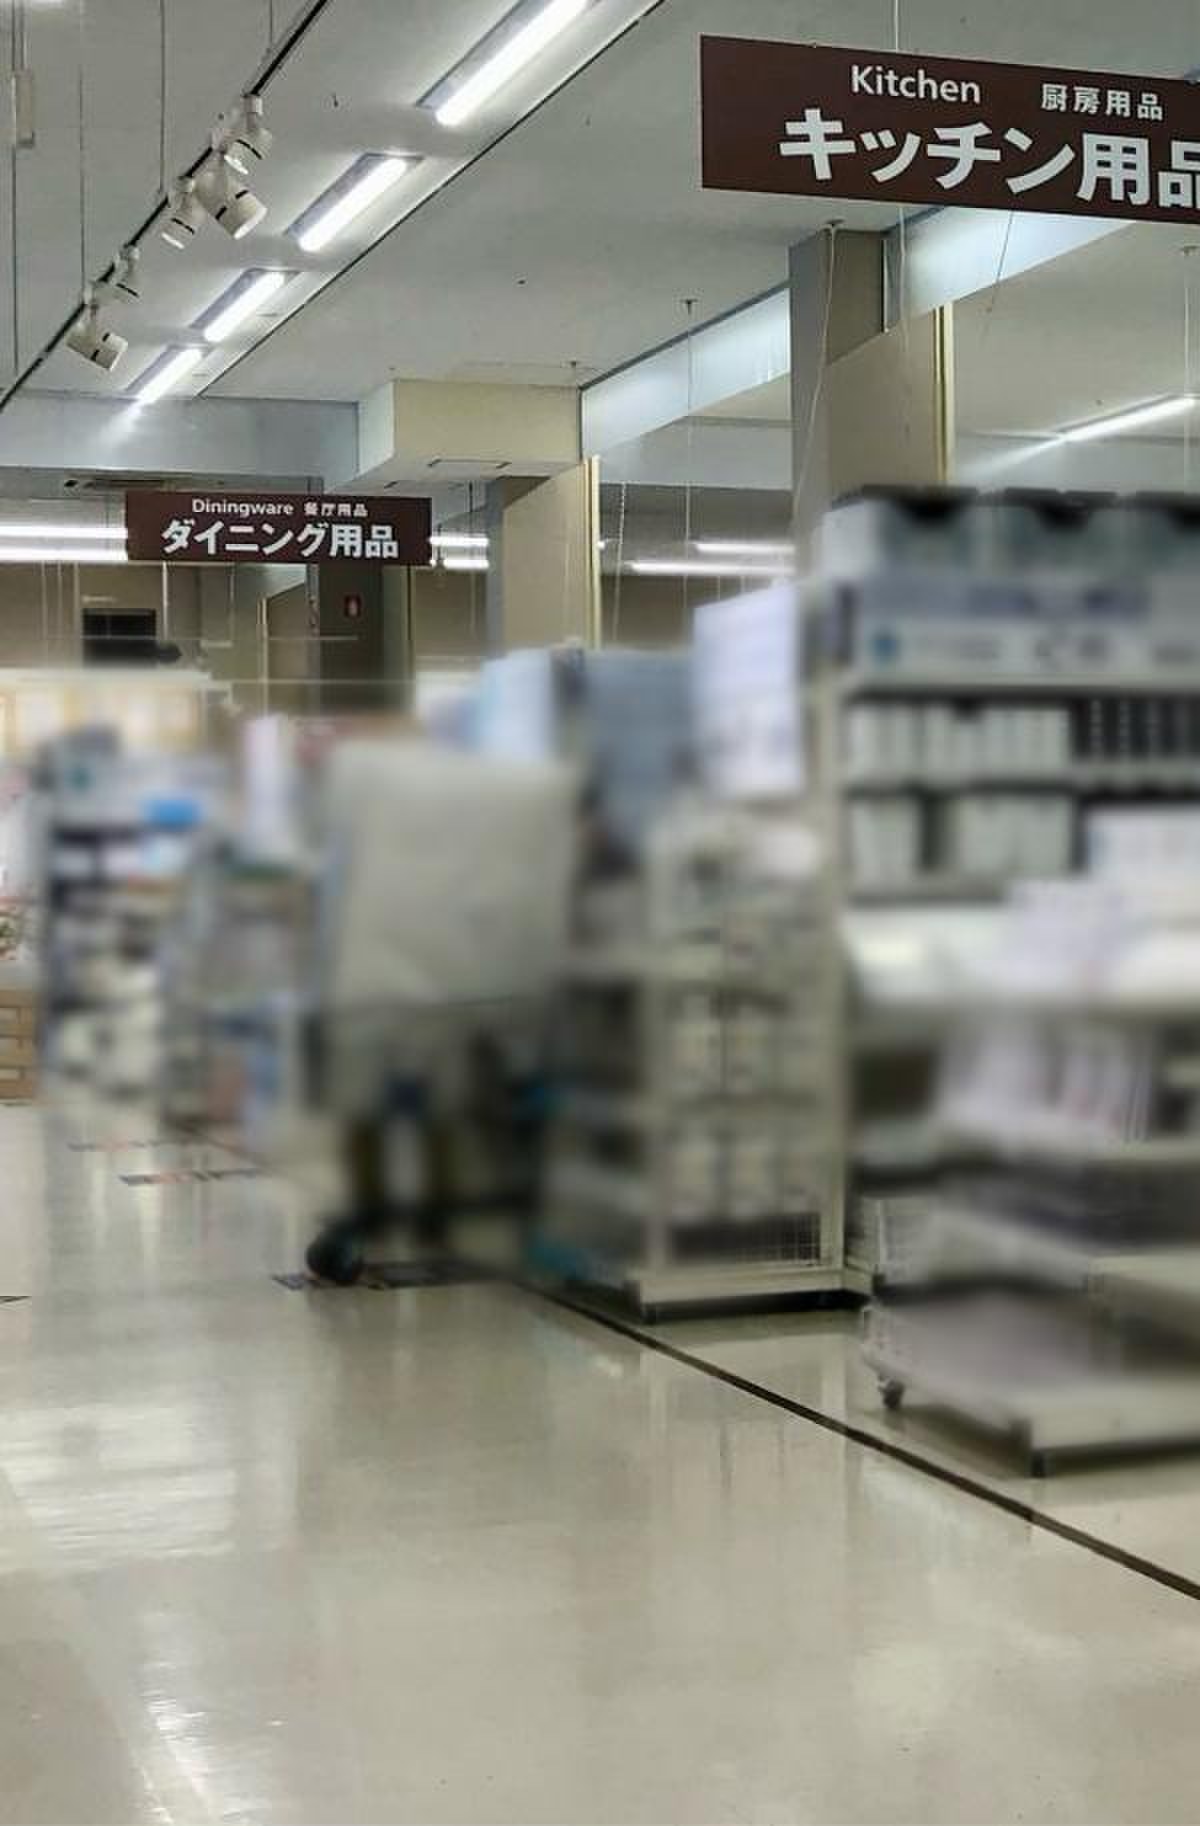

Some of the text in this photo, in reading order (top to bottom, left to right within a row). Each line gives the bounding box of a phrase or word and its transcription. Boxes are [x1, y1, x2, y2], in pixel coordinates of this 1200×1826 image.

[852, 65, 980, 104] Kitchen
[1041, 83, 1163, 121] 厨房用品
[192, 498, 294, 518] Diningware
[161, 518, 399, 559] ダイニング用品
